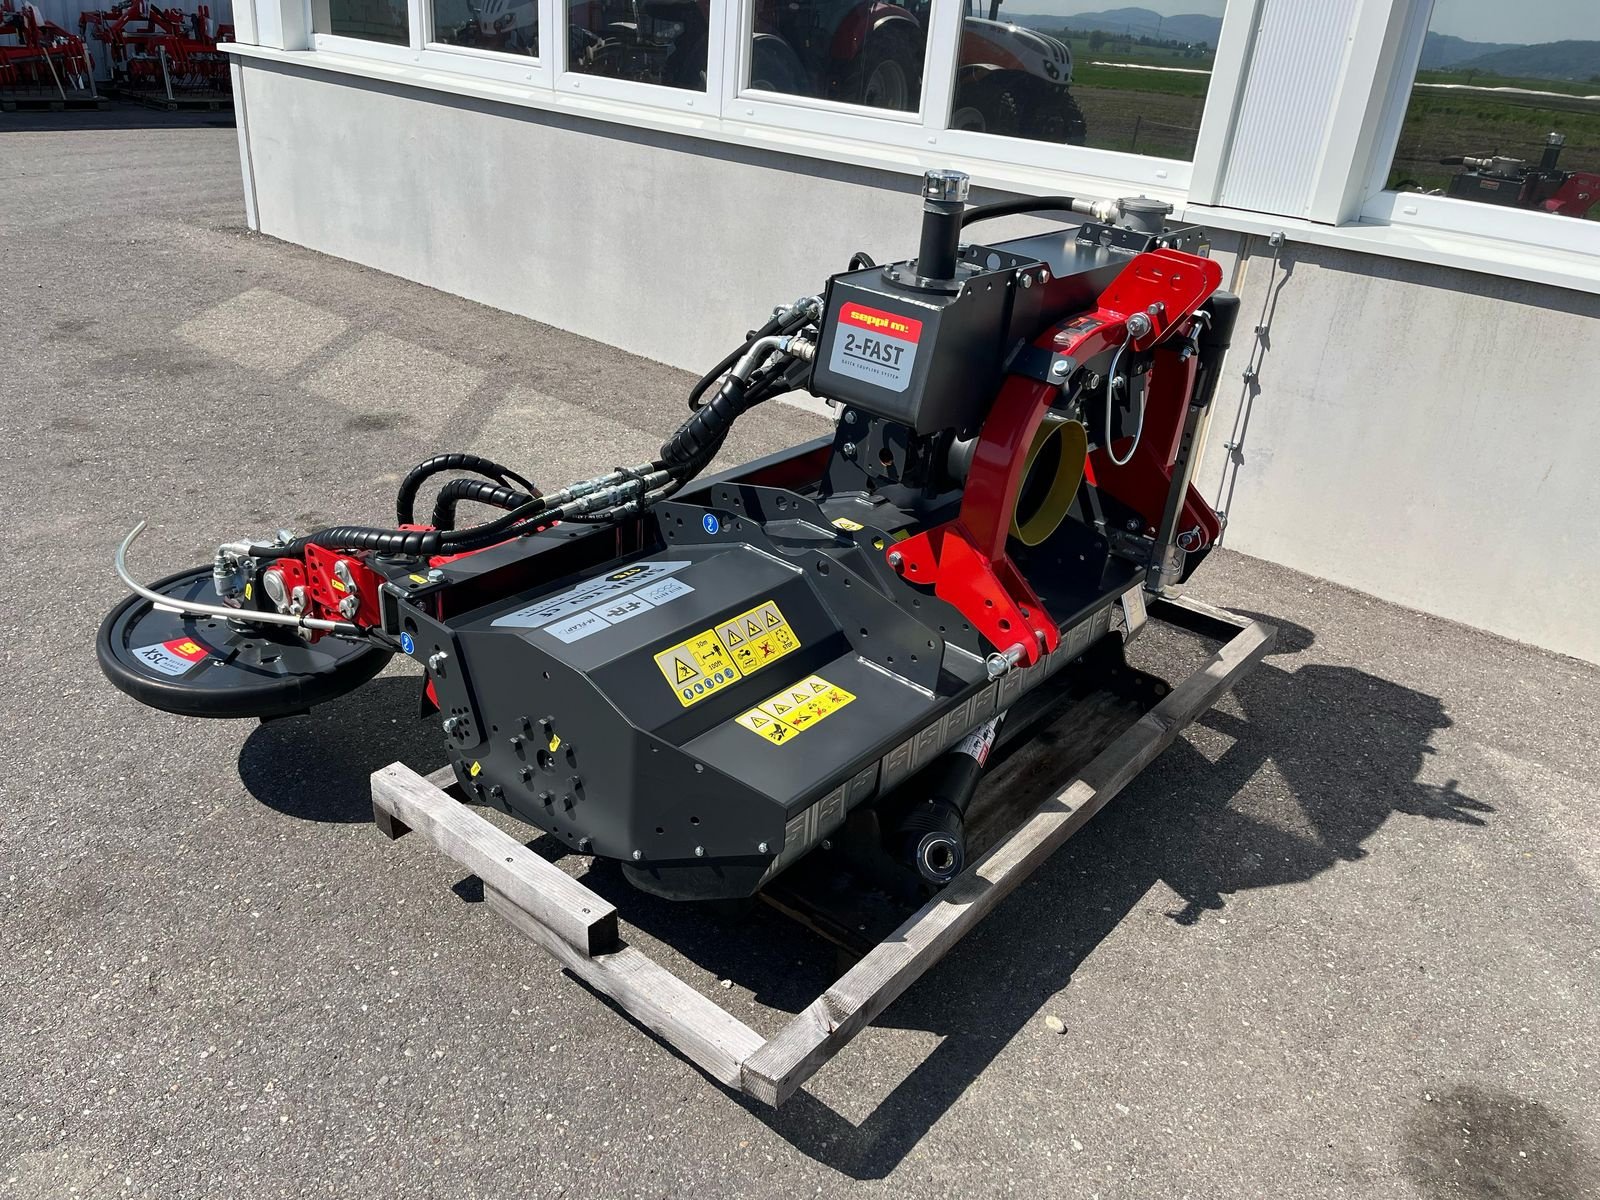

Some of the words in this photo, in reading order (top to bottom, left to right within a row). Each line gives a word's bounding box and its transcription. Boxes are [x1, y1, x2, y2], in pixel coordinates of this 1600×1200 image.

[850, 311, 889, 327] seppi
[844, 333, 905, 365] 2-FAST
[857, 363, 880, 374] COUPLING
[881, 371, 899, 379] SYSTEM
[696, 640, 708, 648] 30m
[782, 641, 793, 651] STOP
[142, 648, 168, 664] XSC
[708, 660, 723, 671] 100ft
